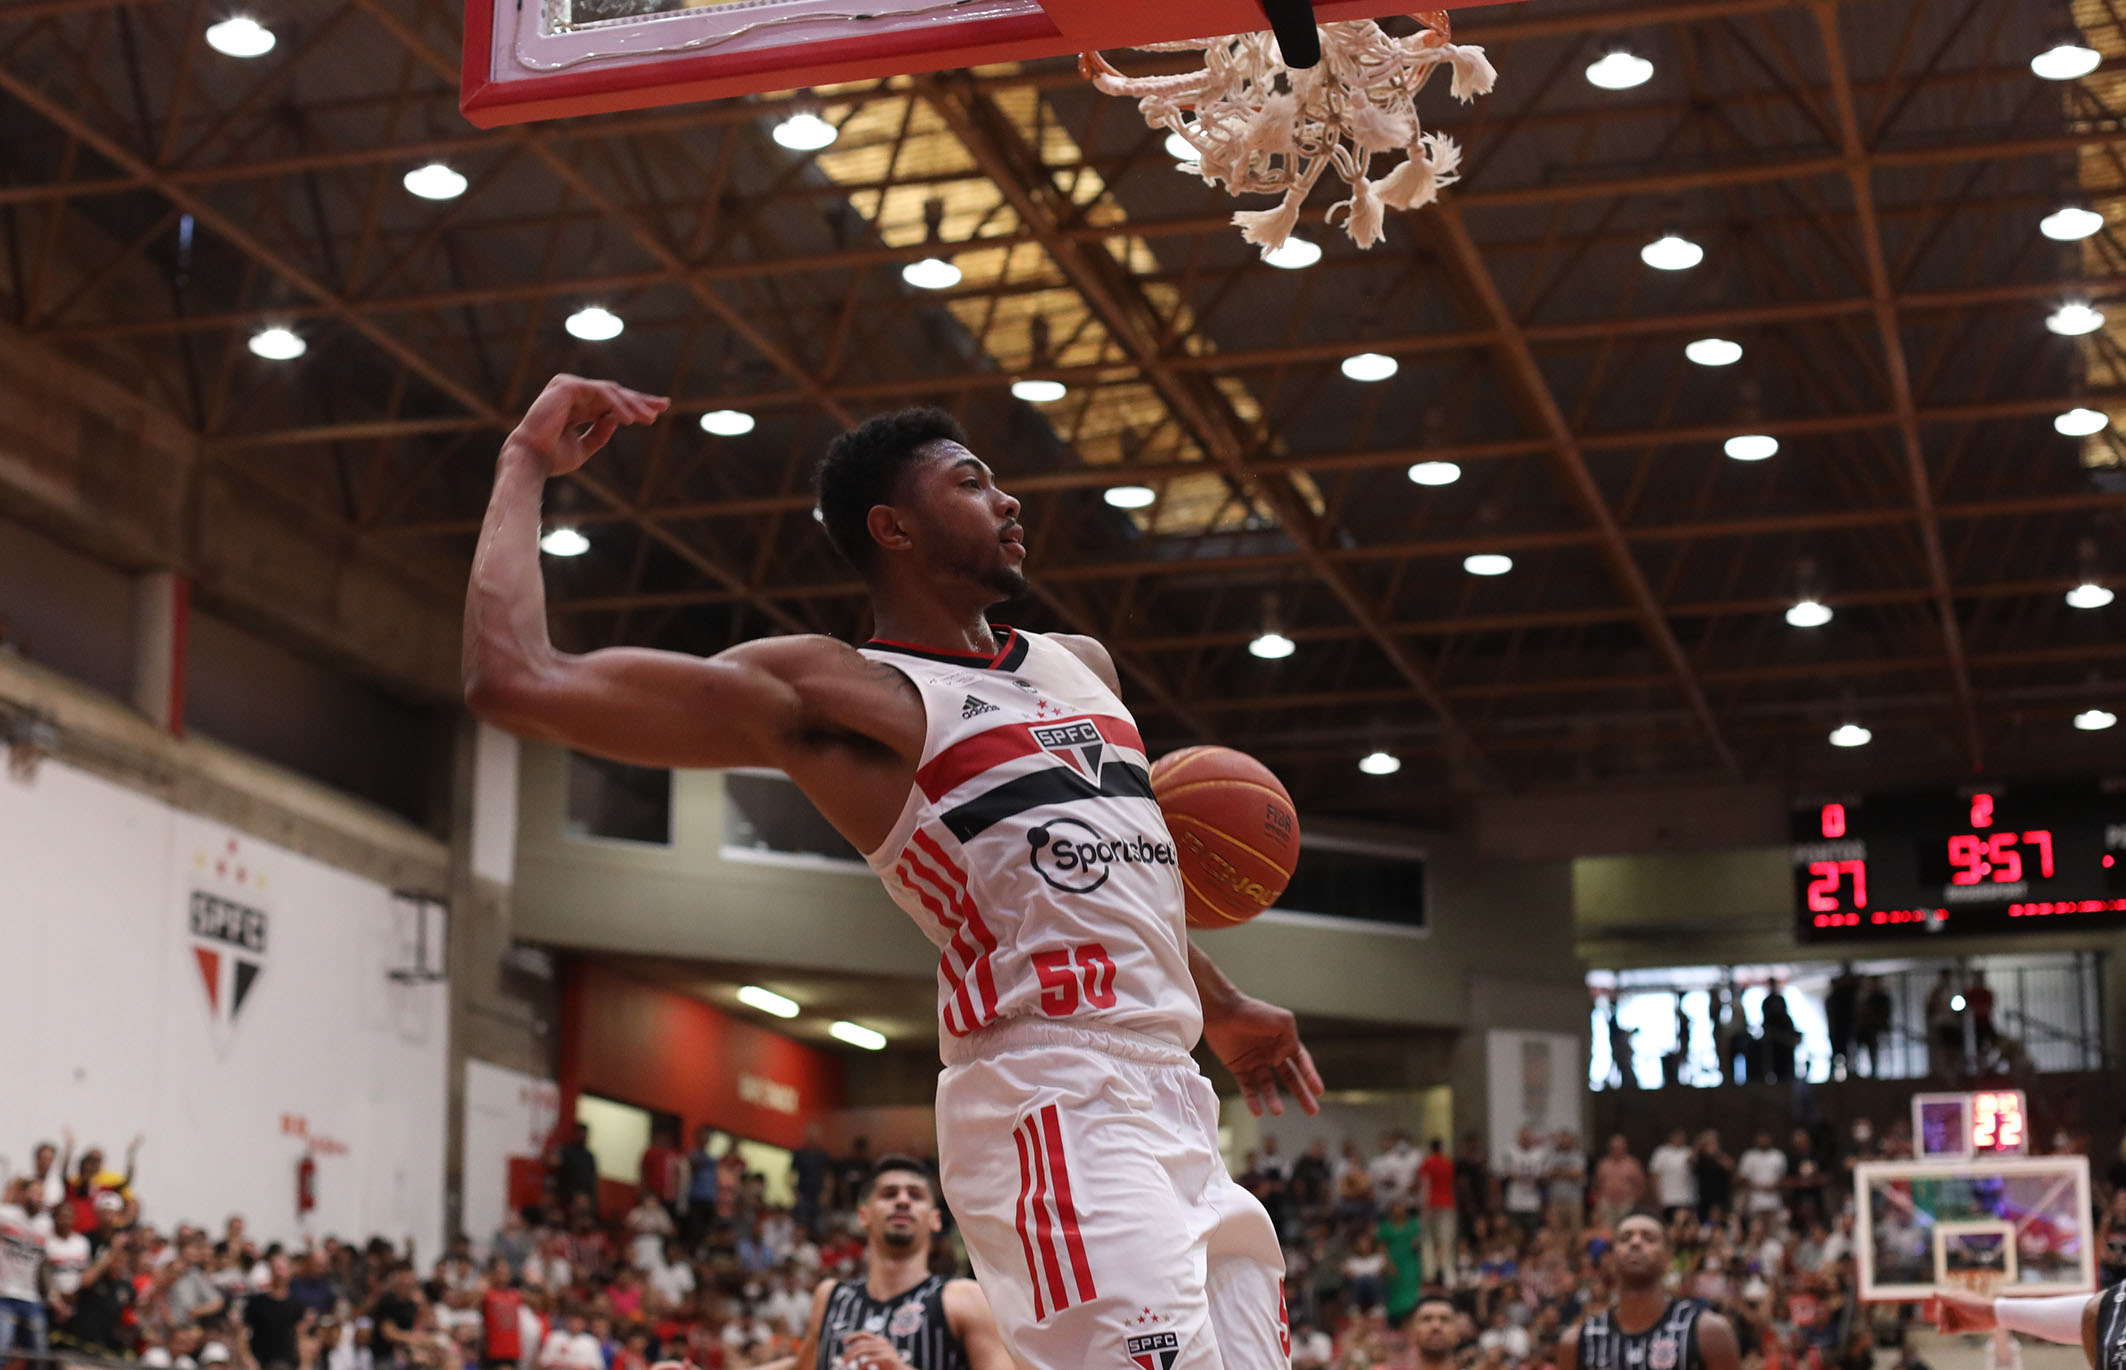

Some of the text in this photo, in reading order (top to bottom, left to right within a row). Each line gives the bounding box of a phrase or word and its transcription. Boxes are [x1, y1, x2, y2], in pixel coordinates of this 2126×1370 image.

[962, 702, 1000, 720] adidas
[1037, 725, 1096, 745] SPFC
[1266, 803, 1292, 833] FIBA
[1822, 804, 1846, 839] 0
[1971, 793, 1994, 828] 2
[1948, 830, 2054, 885] 9:57
[1808, 859, 1867, 912] 27
[1031, 943, 1117, 1016] 50
[1129, 1335, 1175, 1352] SPFC
